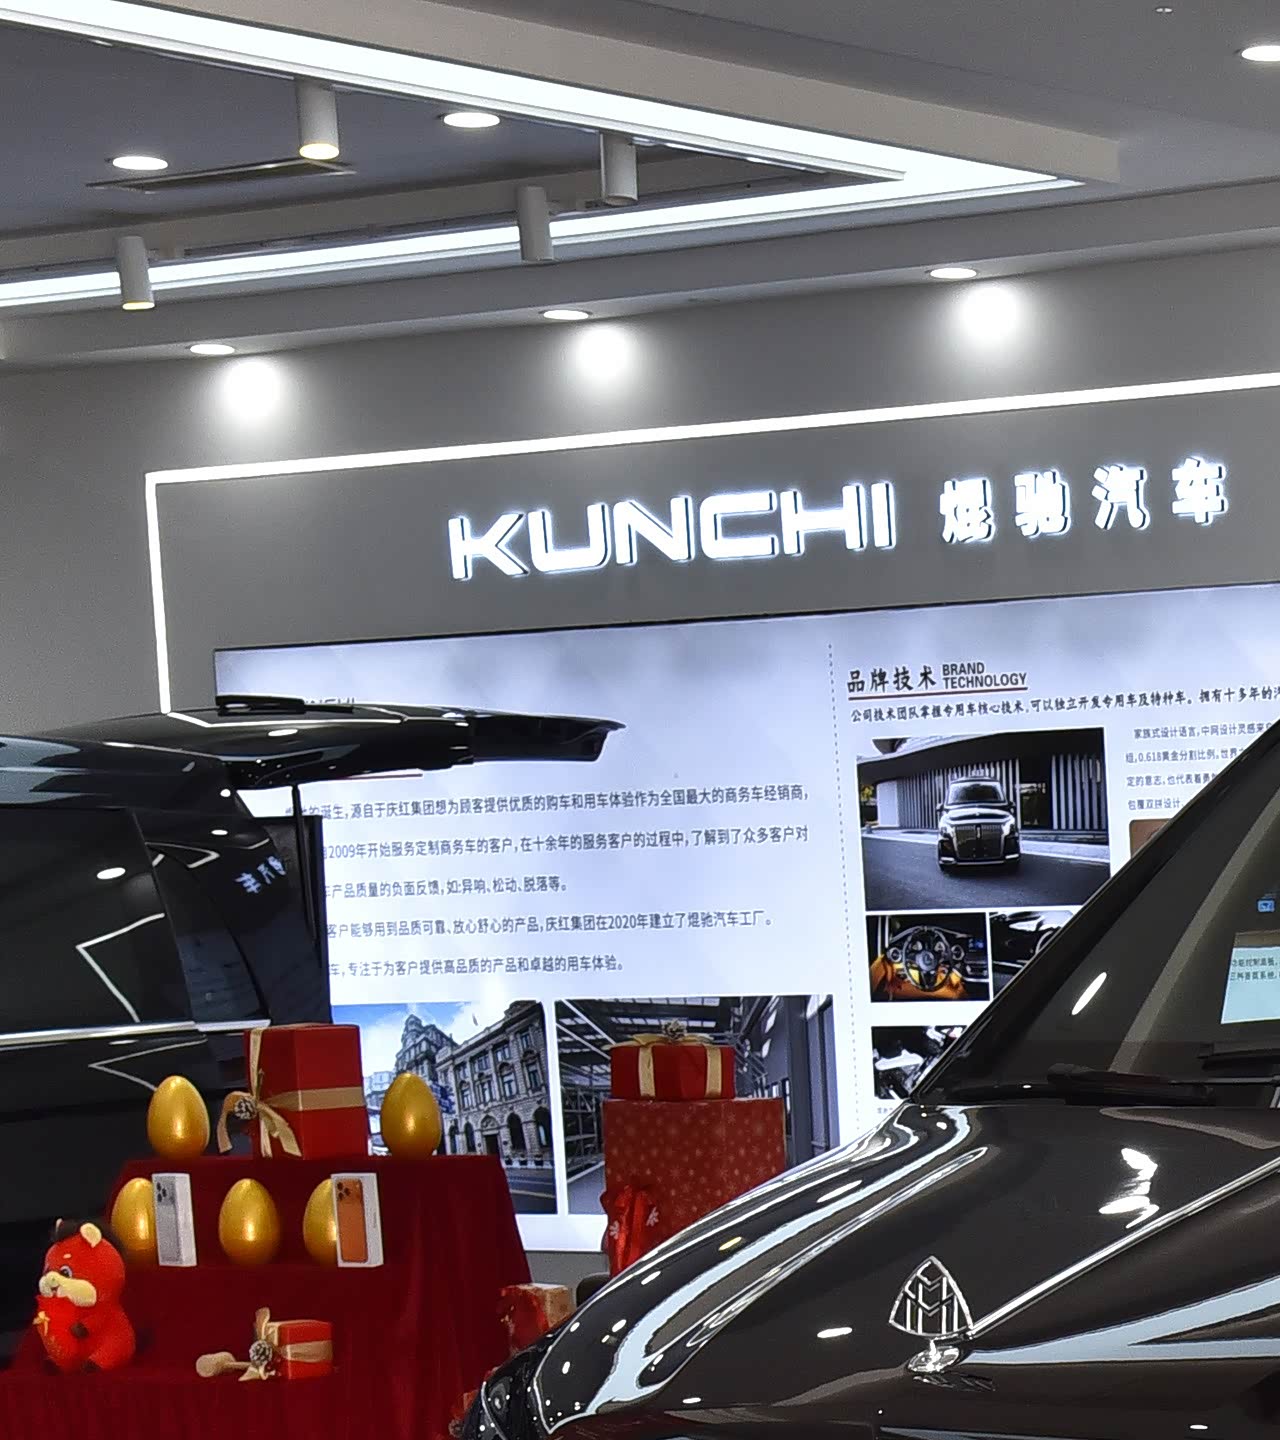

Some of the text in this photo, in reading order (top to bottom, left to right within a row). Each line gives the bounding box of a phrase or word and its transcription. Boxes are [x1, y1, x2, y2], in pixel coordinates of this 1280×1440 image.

[447, 480, 896, 581] KUNCHI
[847, 664, 937, 693] 品牌技术
[942, 661, 985, 677] BRAND
[942, 672, 1028, 690] TECHNOLOGY
[323, 825, 809, 860] 2009年开始服务定制商务车的客户，在十余年的服务客户的过程中，了解到了众多客户对
